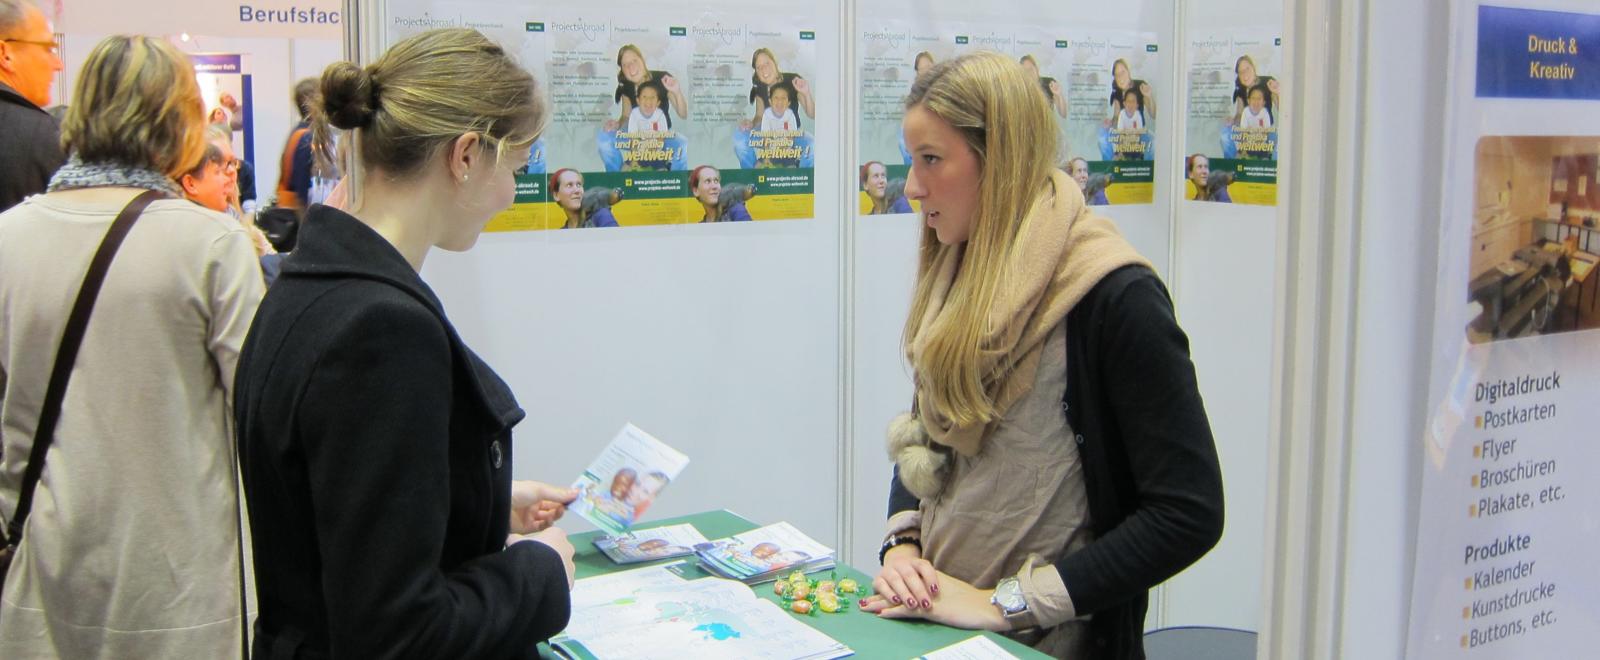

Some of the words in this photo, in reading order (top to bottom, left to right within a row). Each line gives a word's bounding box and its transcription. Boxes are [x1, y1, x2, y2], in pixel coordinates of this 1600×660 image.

[239, 5, 342, 24] Berufsfac
[1528, 34, 1566, 54] Druck
[1568, 37, 1578, 55] &
[1530, 61, 1575, 80] Kreativ
[615, 139, 632, 149] und
[623, 147, 675, 162] weltweit
[749, 138, 764, 147] und
[757, 145, 803, 159] weltweit
[1475, 370, 1561, 404] Digitaldruck
[1484, 403, 1556, 430] Postkarten
[1481, 437, 1517, 462] Flyer
[1479, 459, 1556, 489] Broschüren
[1477, 493, 1535, 519] Plakate,
[1538, 486, 1567, 504] etc.
[1464, 533, 1532, 565] Produkte
[1473, 559, 1536, 591] Kalender
[1470, 581, 1556, 620] Kunstdrucke
[1468, 618, 1528, 649] Buttons,
[1531, 610, 1558, 630] etc.
